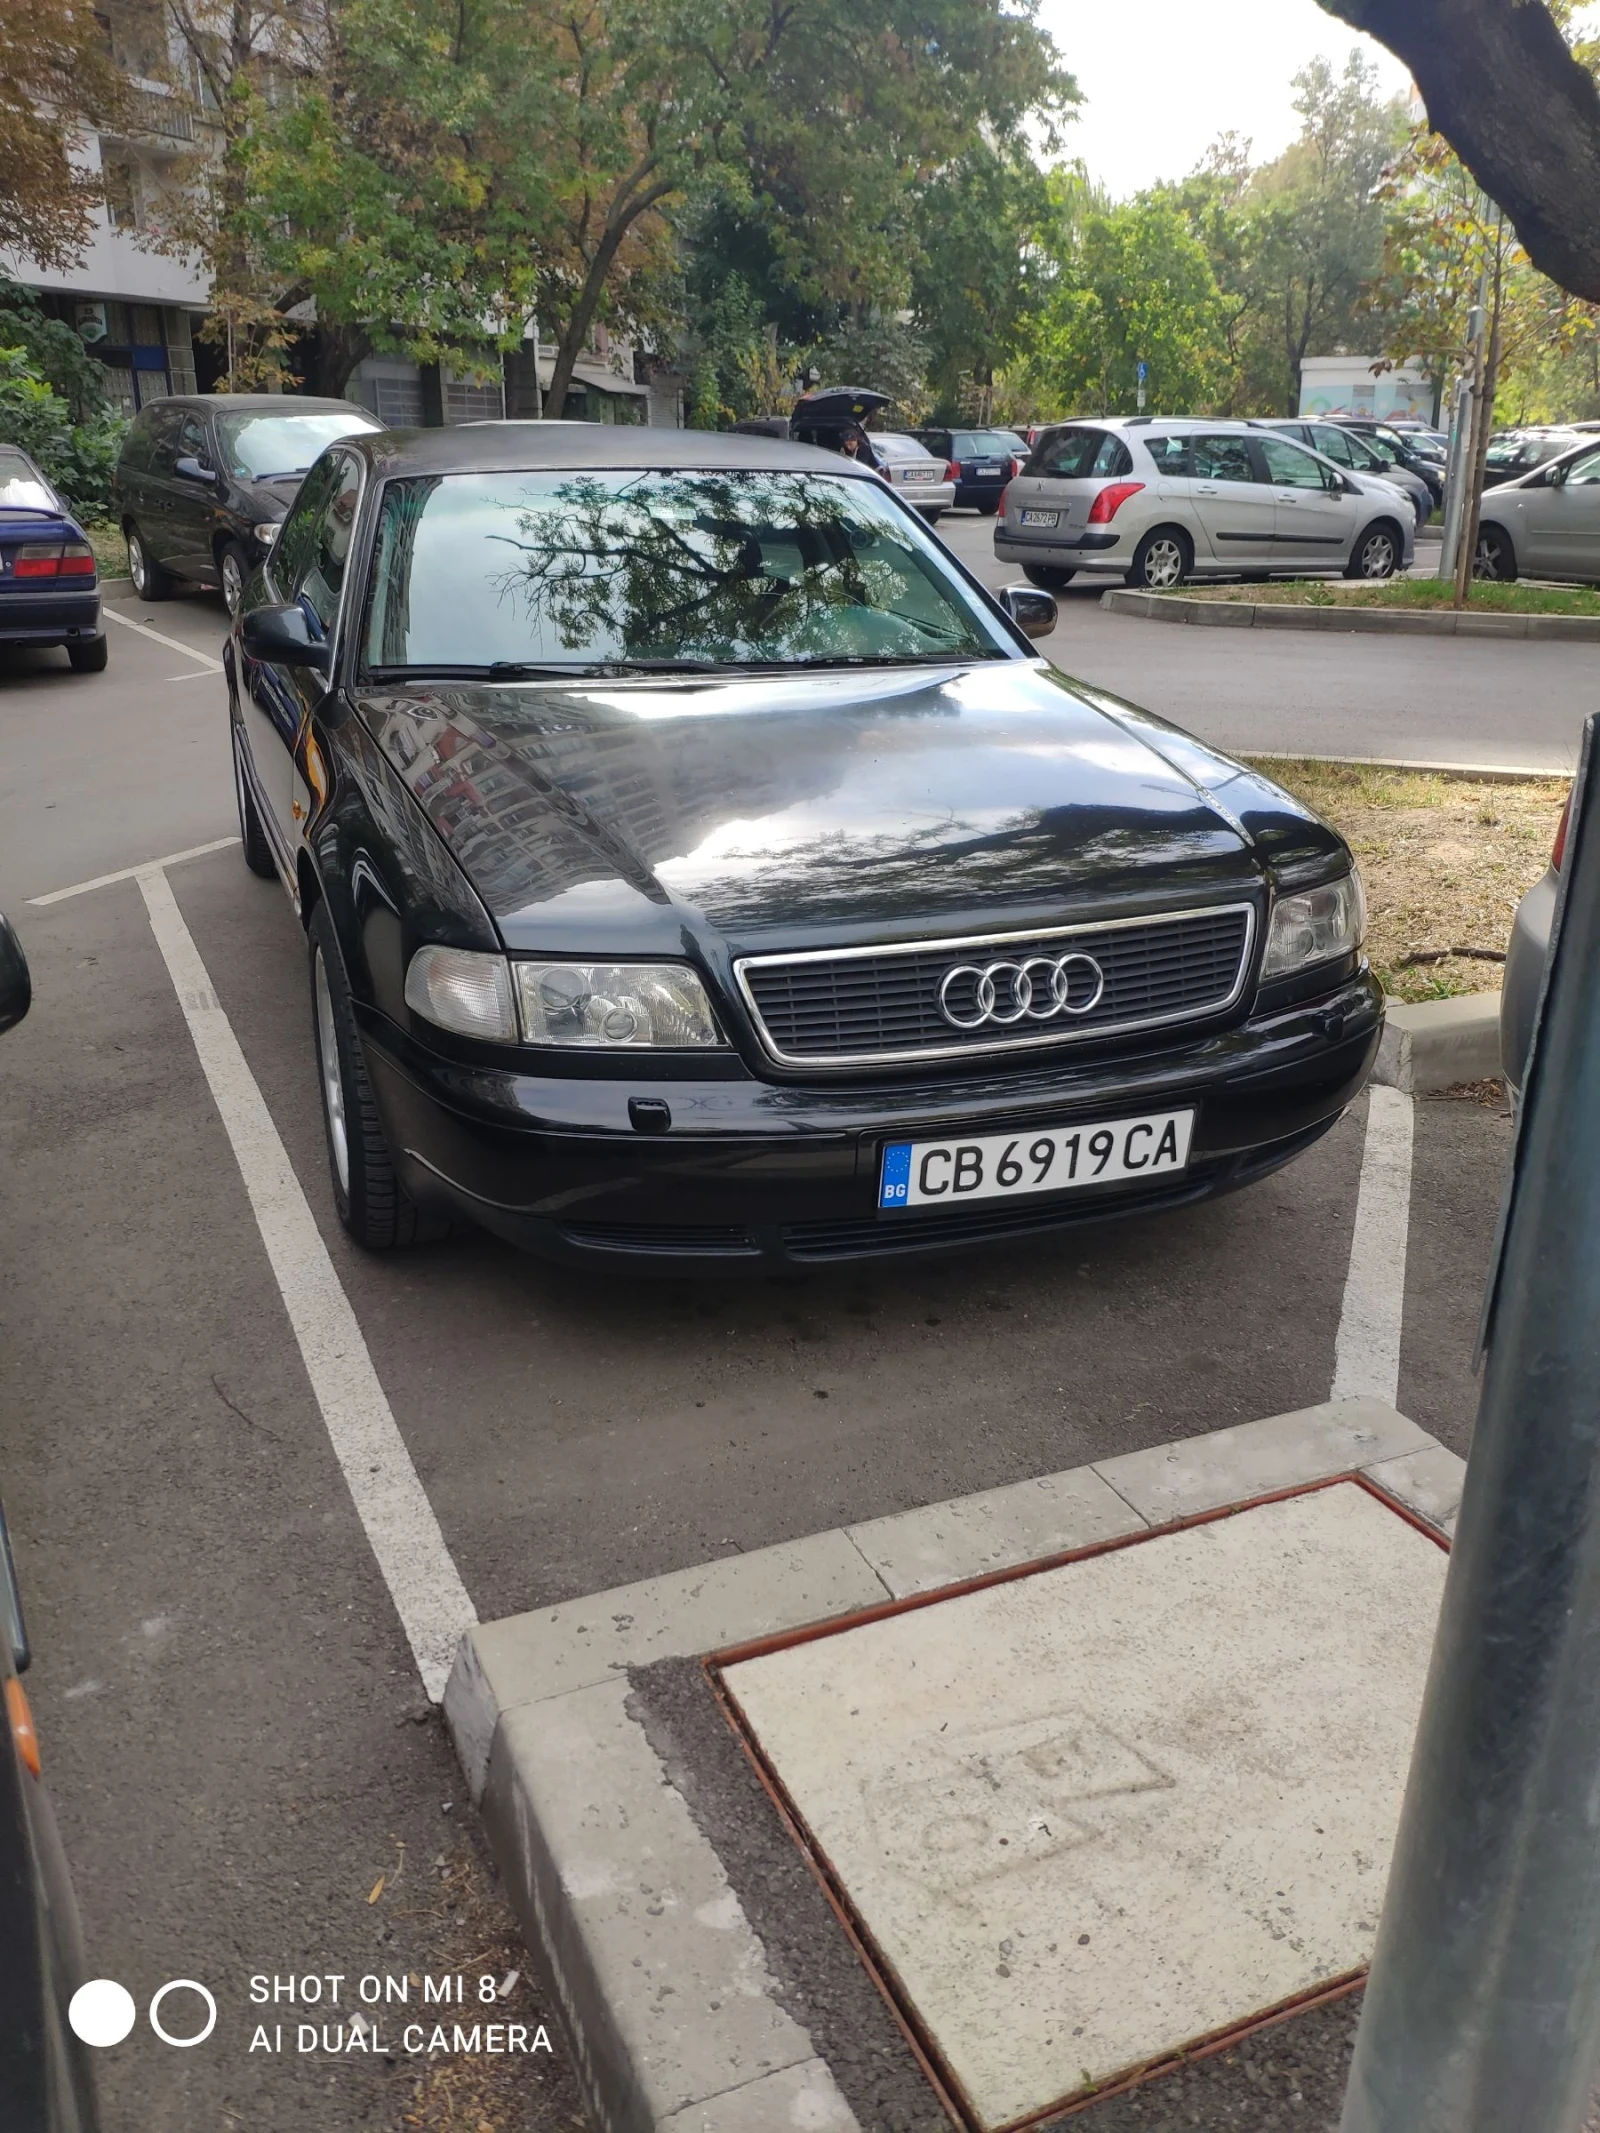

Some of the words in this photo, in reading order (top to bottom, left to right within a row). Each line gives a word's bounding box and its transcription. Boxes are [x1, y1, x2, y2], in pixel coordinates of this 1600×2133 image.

[918, 1145, 984, 1196] CB
[995, 1129, 1114, 1188] 6919
[1123, 1119, 1178, 1170] CA
[884, 1183, 906, 1199] BG
